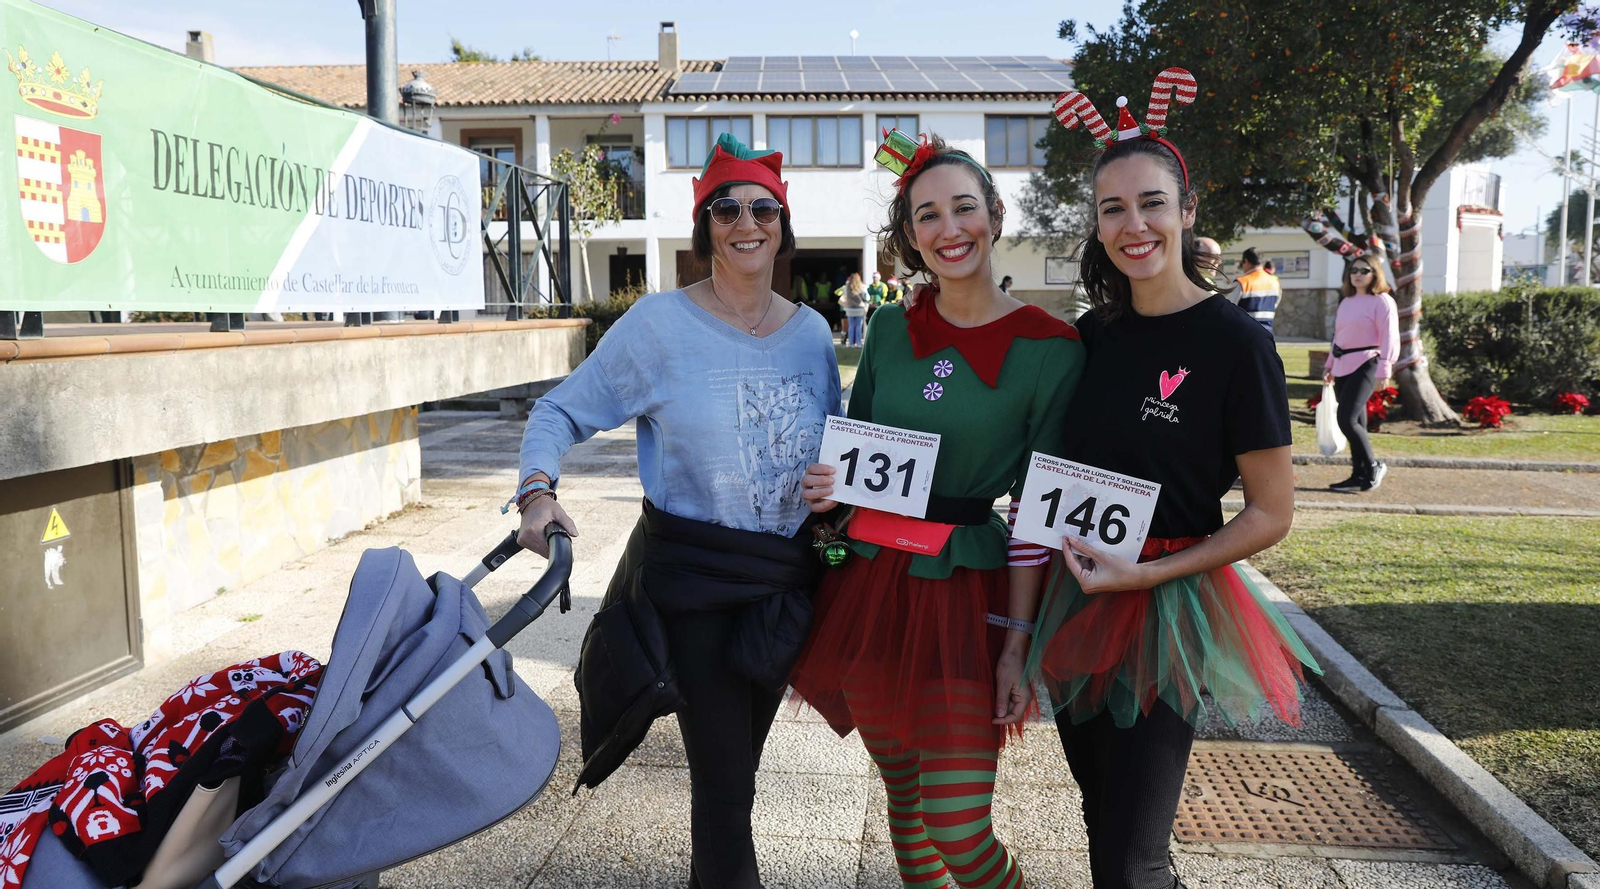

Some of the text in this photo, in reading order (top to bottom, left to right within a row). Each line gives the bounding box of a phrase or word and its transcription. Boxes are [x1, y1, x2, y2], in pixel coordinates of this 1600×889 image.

[150, 127, 308, 213] DELEGACIÓN
[312, 166, 338, 218] DE
[343, 173, 424, 230] DEPORTES
[170, 264, 420, 295] Ayuntamiento de Castellar de la Frontera
[1140, 396, 1179, 412] princesa
[1141, 406, 1180, 424] gabriela
[830, 424, 934, 448] CASTELLAR DE LA FRONTERA
[832, 418, 852, 428] CROSS
[852, 422, 881, 432] POPULAR
[908, 433, 938, 442] SOLIDARIO
[840, 447, 917, 498] 131
[1035, 462, 1152, 498] CASTELLAR DE LA FRONTERA
[1037, 456, 1059, 467] CROSS
[1060, 462, 1091, 475] POPULAR
[1091, 470, 1115, 481] LÚDICO
[1121, 478, 1157, 492] SOLIDARIO
[1040, 487, 1131, 545] 146
[325, 739, 381, 788] Inglesina APTICA
